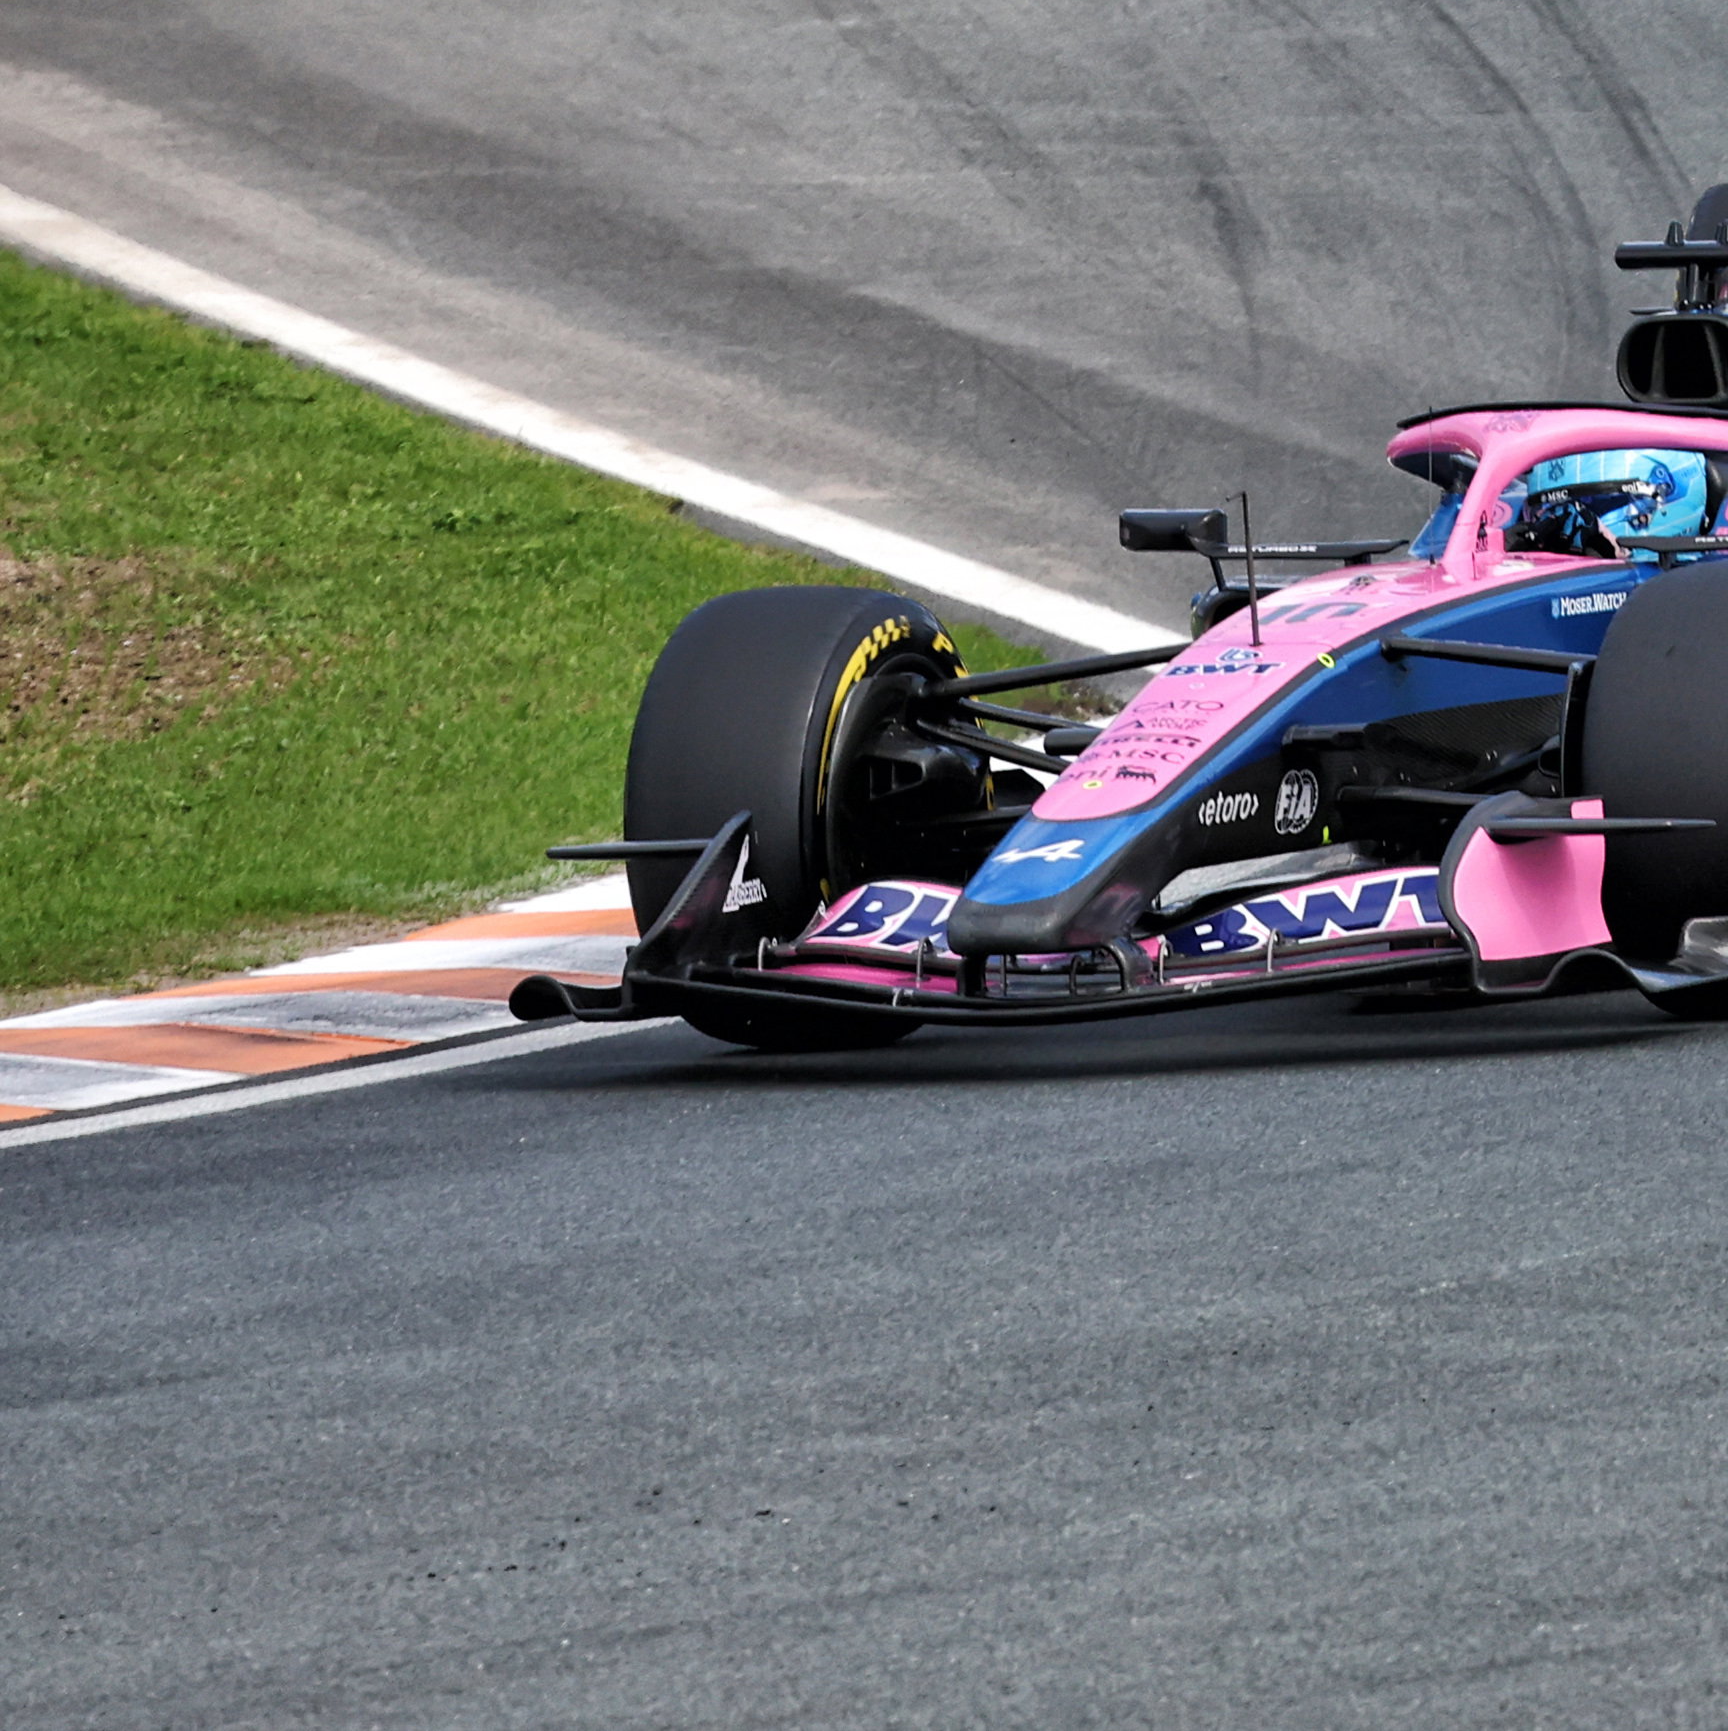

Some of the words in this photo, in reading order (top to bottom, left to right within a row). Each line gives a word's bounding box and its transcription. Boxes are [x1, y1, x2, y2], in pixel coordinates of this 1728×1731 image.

[1546, 489, 1569, 502] MSC
[1163, 662, 1286, 676] BWT
[1132, 700, 1225, 713] CATO
[1110, 749, 1186, 765] MSC
[1063, 765, 1113, 783] eni
[1166, 871, 1443, 958] BWT
